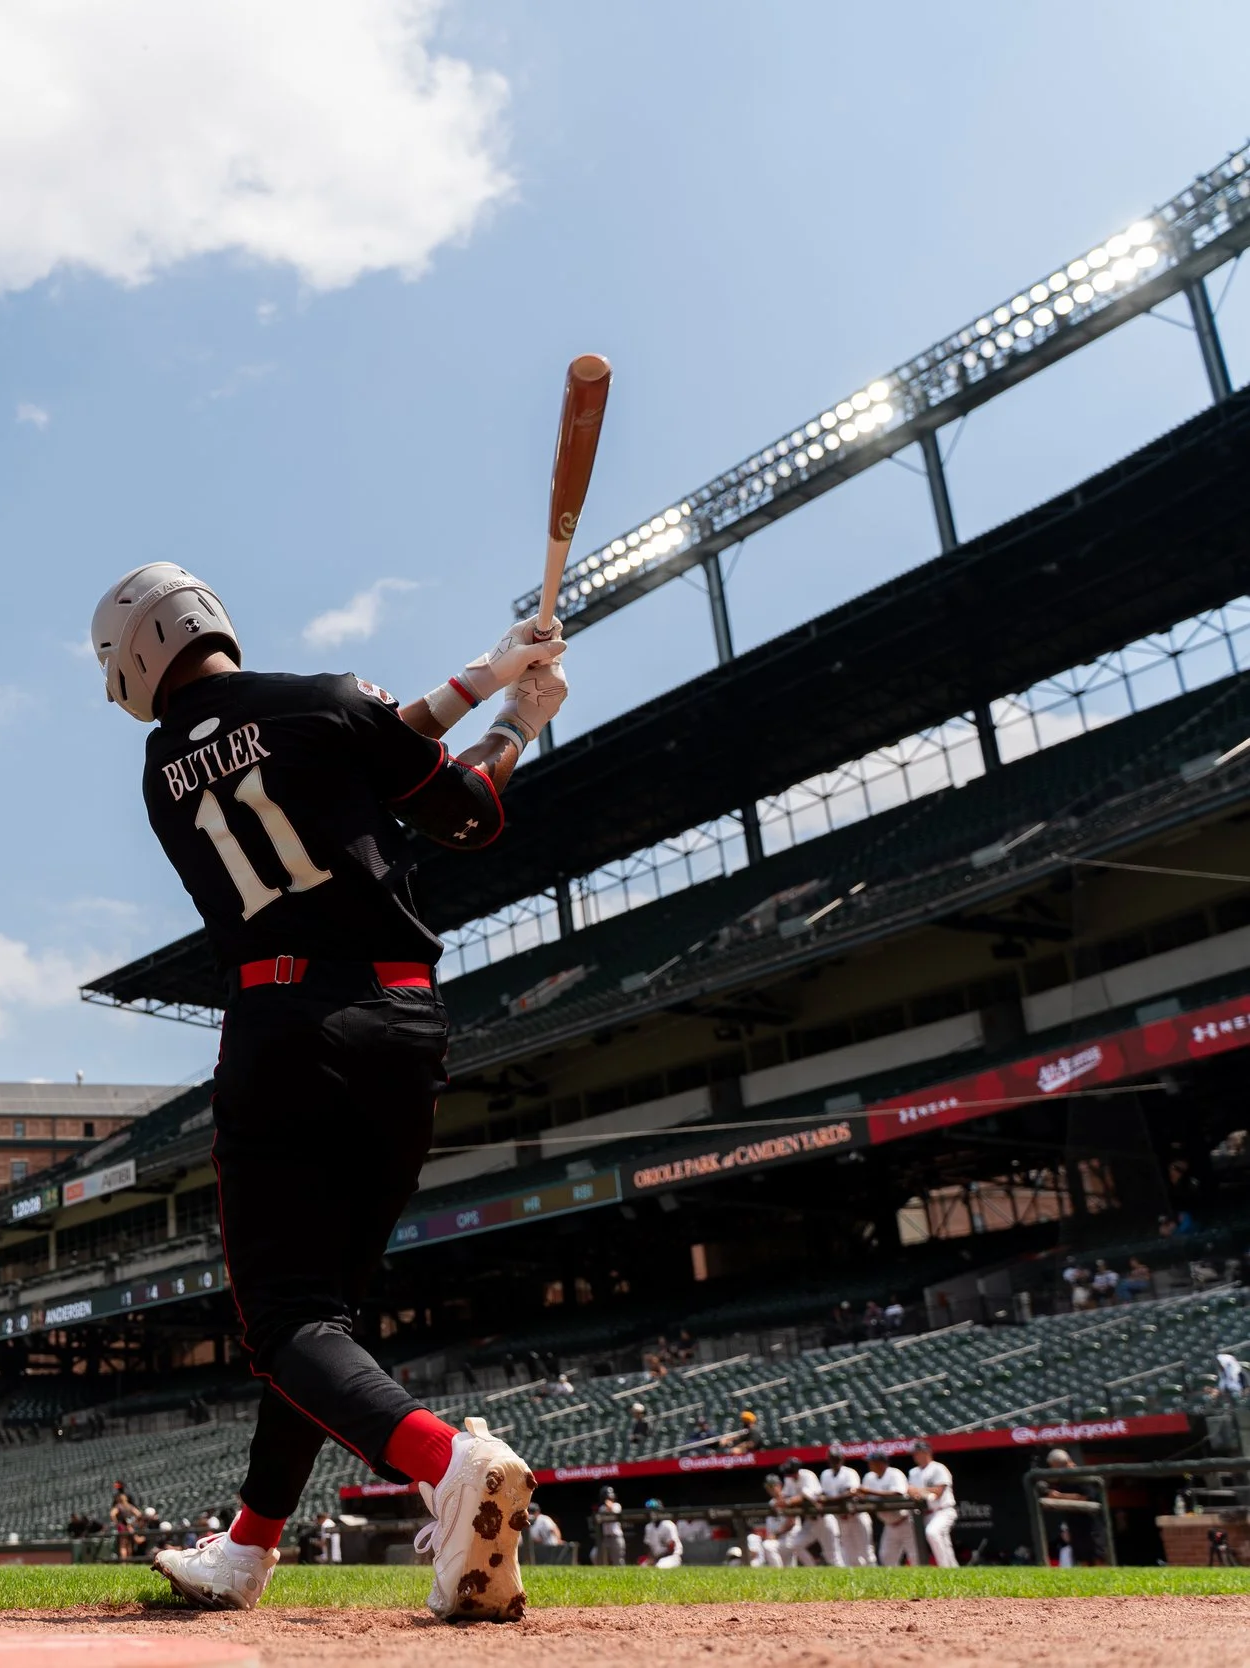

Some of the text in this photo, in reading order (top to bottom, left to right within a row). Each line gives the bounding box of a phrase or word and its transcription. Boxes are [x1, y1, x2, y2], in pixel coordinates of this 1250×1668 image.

[161, 722, 272, 802] BUTLER
[194, 764, 334, 922] 11
[634, 1160, 686, 1188] ORIOLE
[685, 1152, 721, 1177] PARK
[735, 1133, 801, 1166] CAMDEN
[800, 1121, 852, 1151] YARDS
[456, 1210, 480, 1229] OPS
